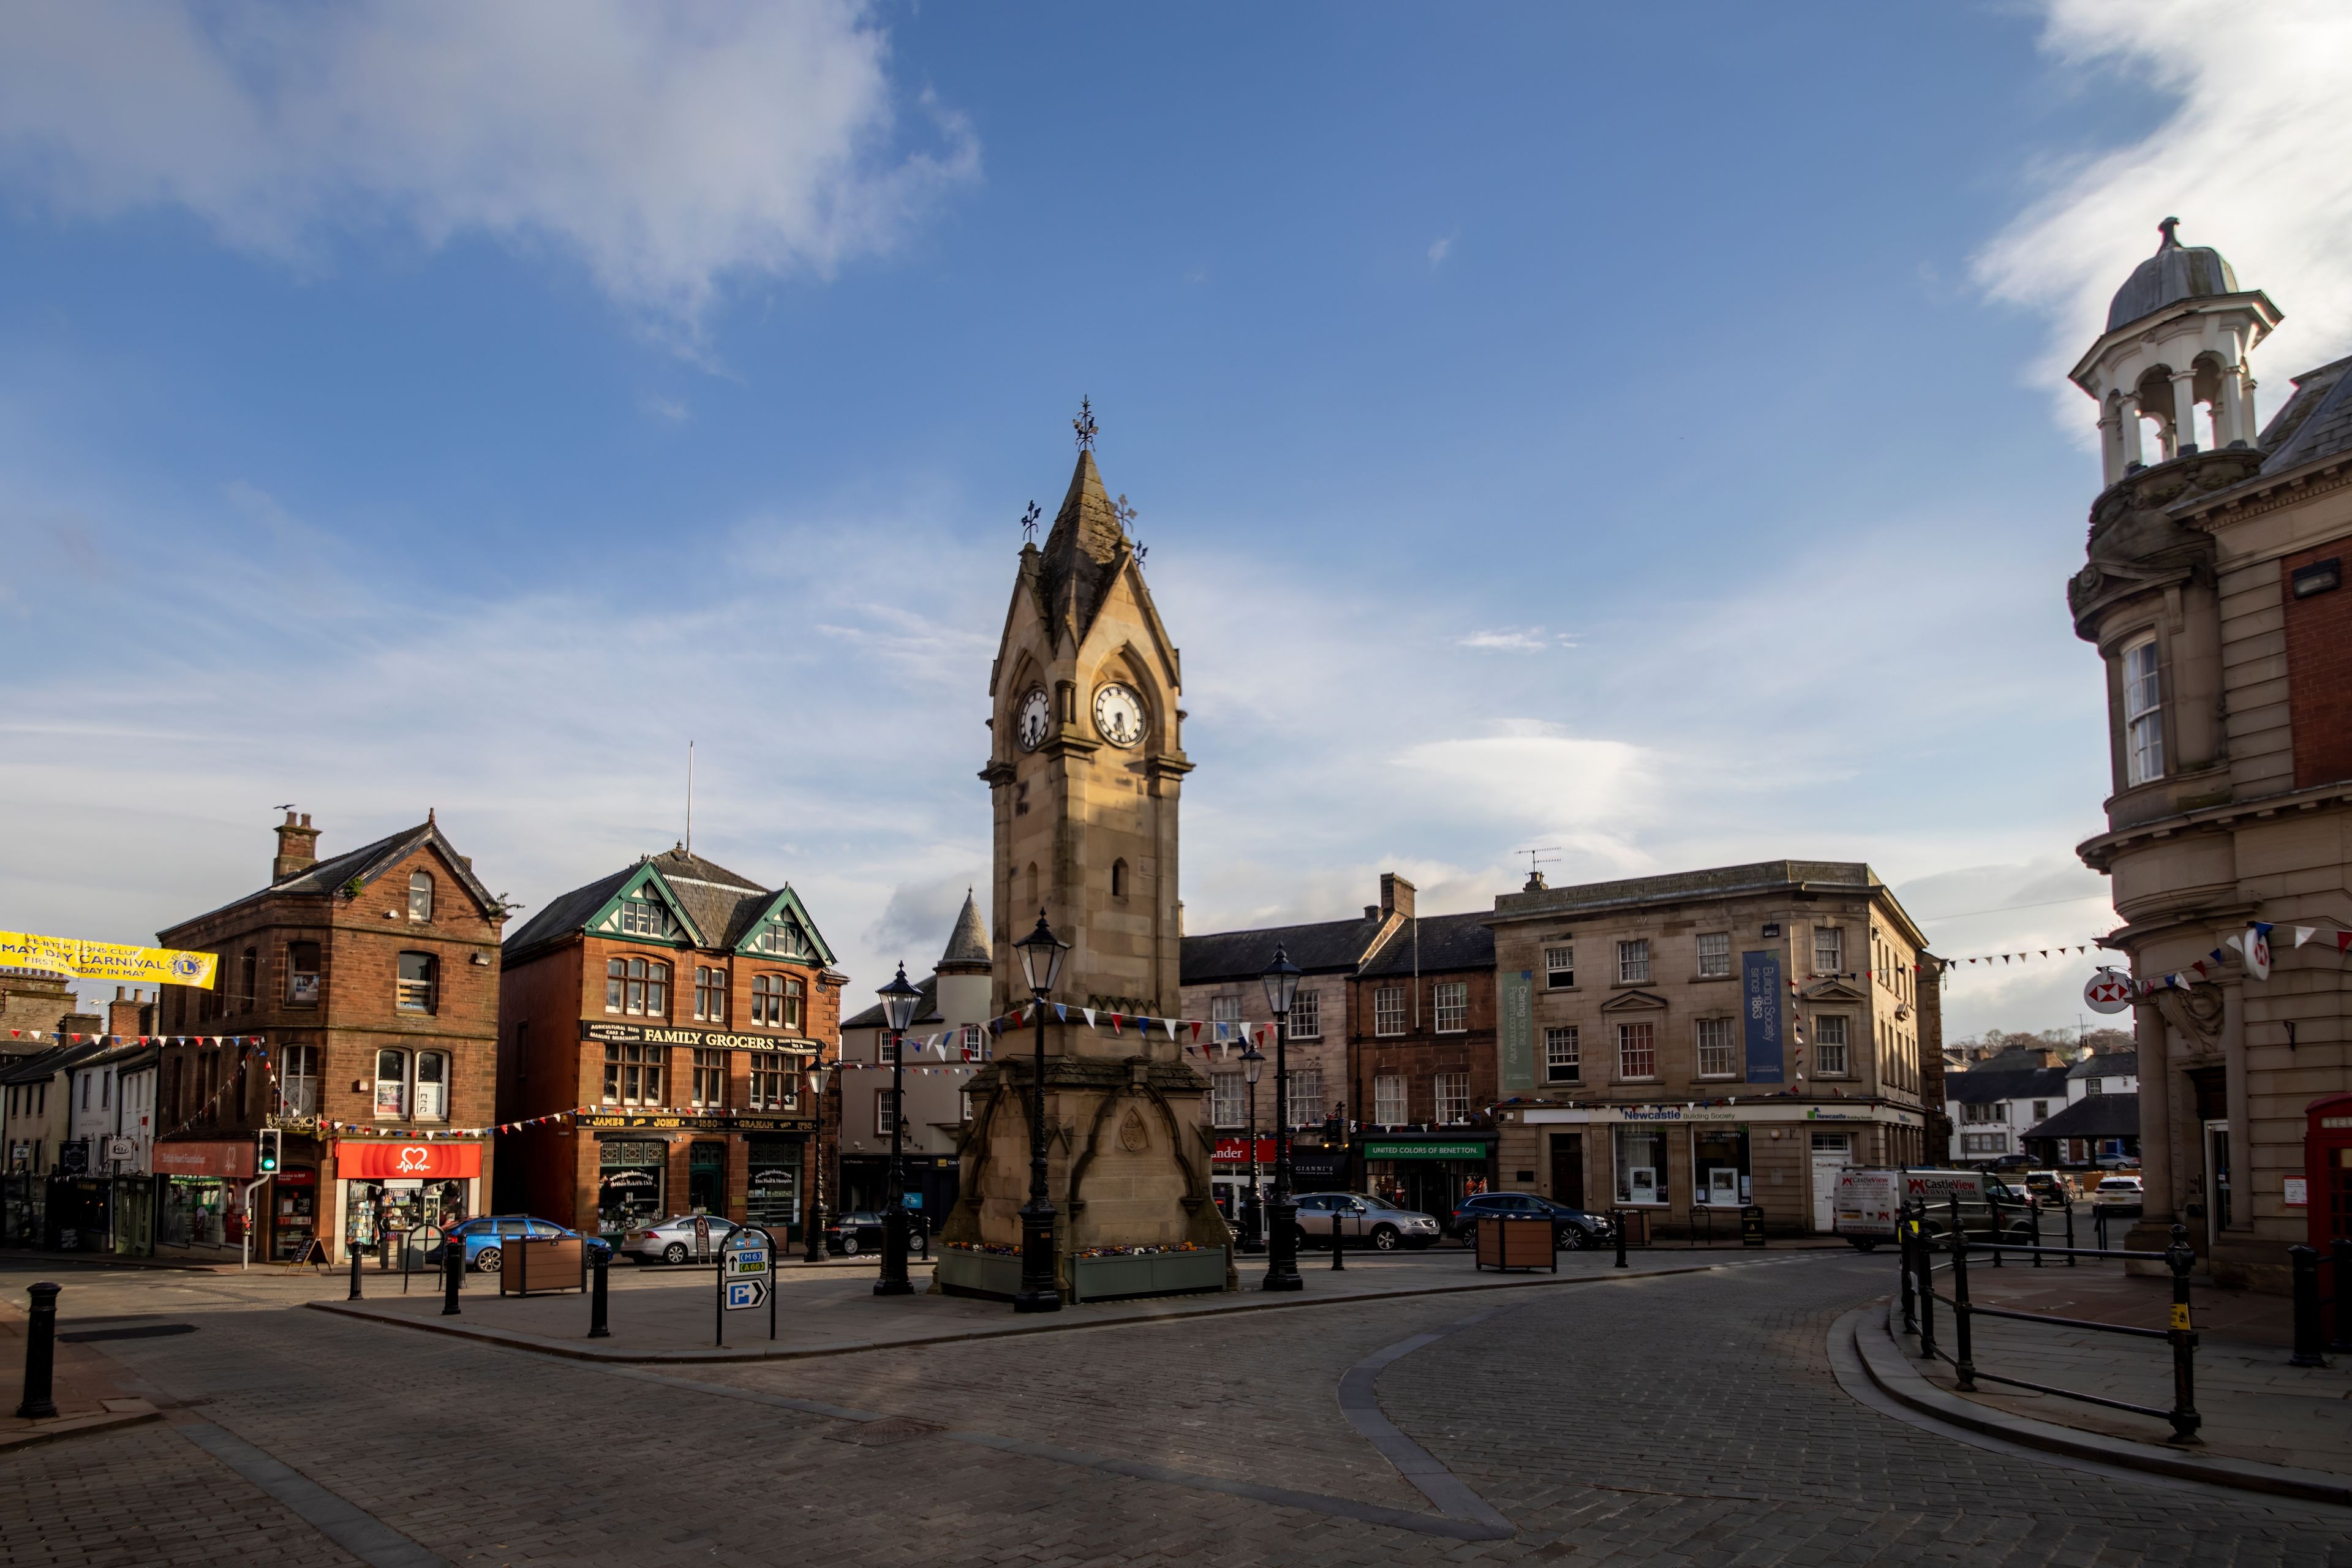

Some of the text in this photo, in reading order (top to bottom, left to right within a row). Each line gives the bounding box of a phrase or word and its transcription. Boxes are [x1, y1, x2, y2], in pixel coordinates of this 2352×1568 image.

[2, 944, 165, 970] MAY DAY CARNIVAL
[24, 957, 55, 966] FIRST
[1751, 967, 1762, 1019] since 1863
[1517, 986, 1527, 1017] Caring
[1762, 967, 1775, 1041] Building Society
[644, 1029, 774, 1050] FAMILY GROCERS
[1624, 1110, 1680, 1120] Newcastle
[592, 1117, 625, 1126] JAMES
[654, 1118, 680, 1127] JOHN
[739, 1120, 774, 1129] GRAHAM
[1925, 1179, 1975, 1189] CastleView
[740, 1253, 761, 1262] (M6)
[740, 1263, 765, 1272] (A66)
[735, 1287, 749, 1303] P
